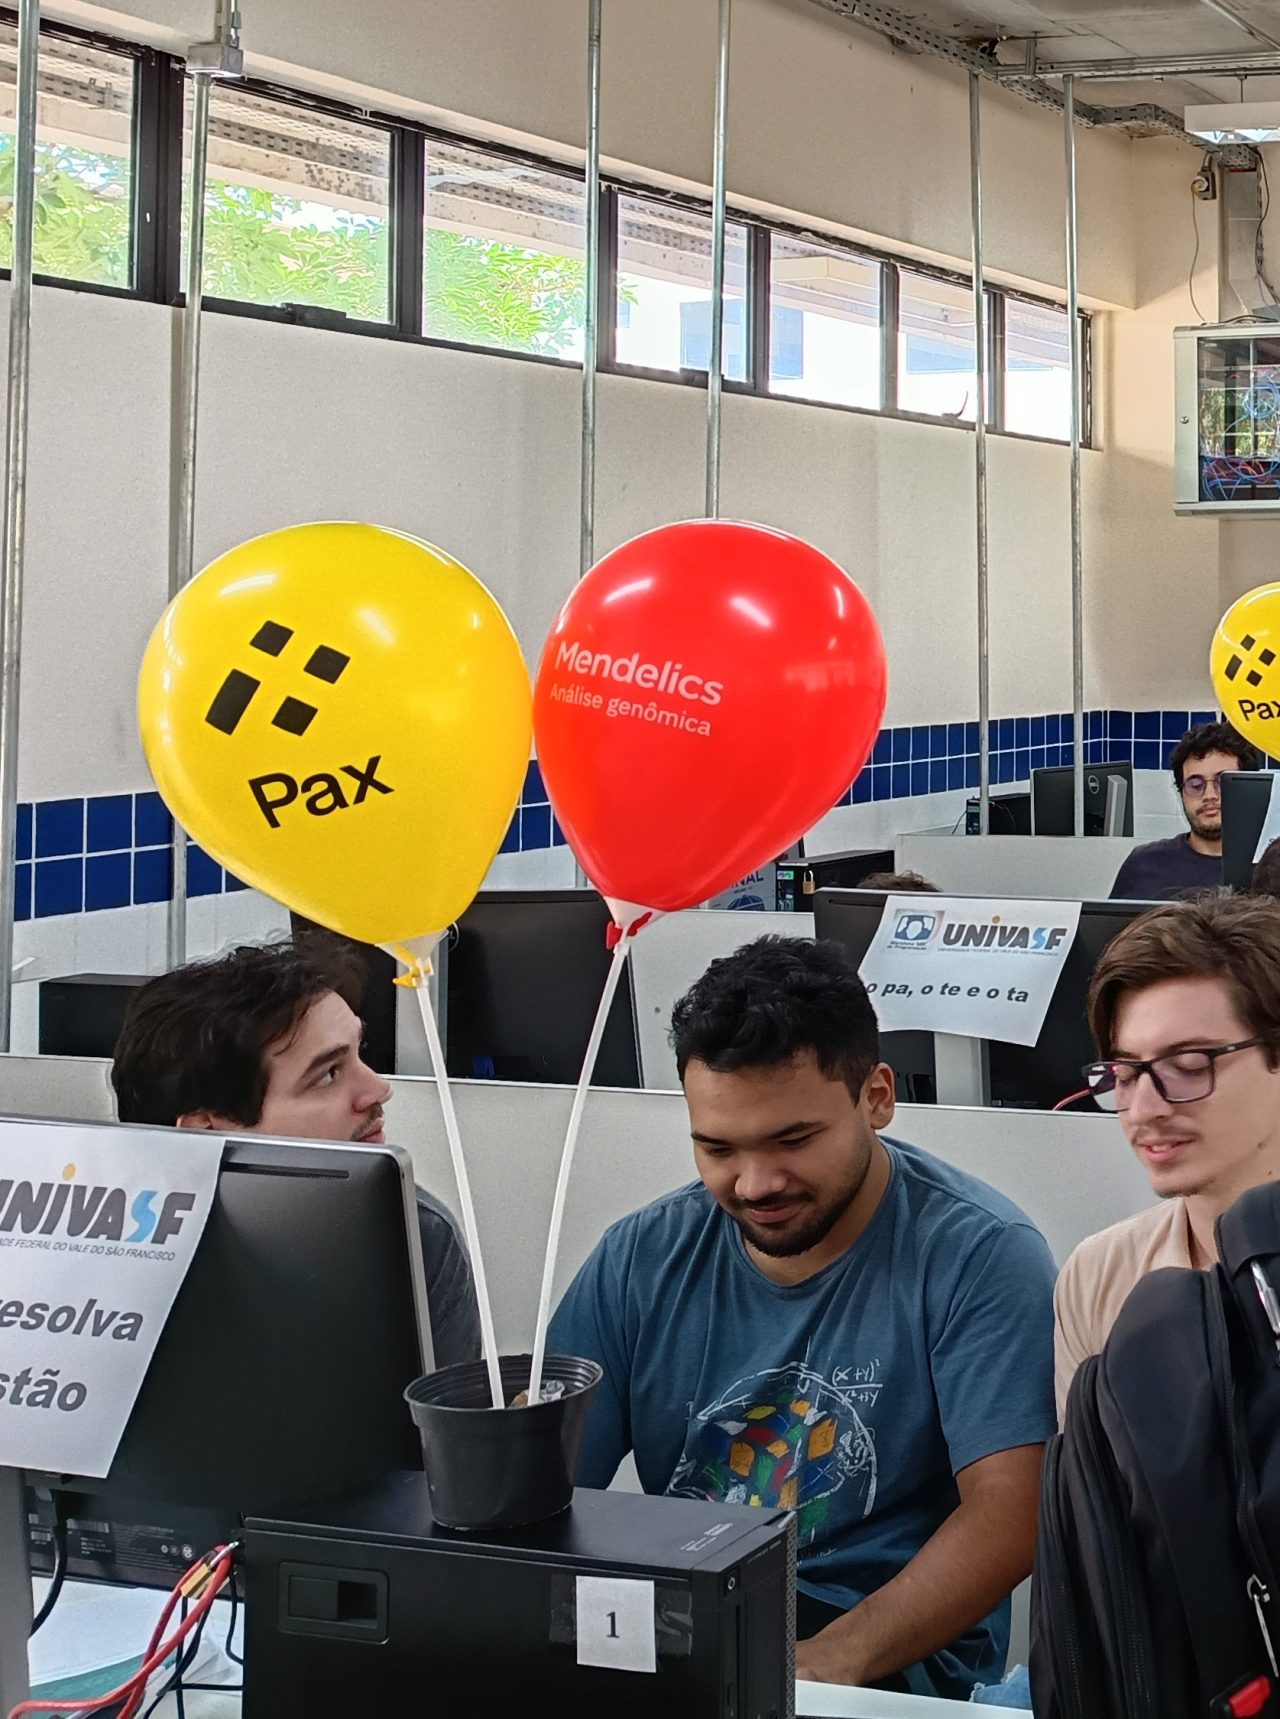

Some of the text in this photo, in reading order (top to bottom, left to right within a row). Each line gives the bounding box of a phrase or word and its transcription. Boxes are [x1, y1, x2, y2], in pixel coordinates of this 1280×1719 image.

[554, 640, 724, 706] Mendelics
[549, 683, 712, 737] Análise genômica
[247, 755, 395, 829] Pax
[942, 915, 1068, 951] UNIVASF
[881, 983, 913, 998] pa,
[920, 984, 934, 995] o
[940, 982, 961, 996] te
[967, 986, 980, 997] e
[986, 987, 1000, 999] o
[1006, 986, 1029, 1003] ta
[15, 1239, 52, 1250] FEDERAL
[53, 1242, 67, 1251] DO
[68, 1243, 90, 1253] VALE
[90, 1245, 105, 1255] DO
[105, 1246, 125, 1257] SÃO
[125, 1249, 176, 1261] FRANCISCO
[0, 1298, 144, 1342] esolva
[605, 1611, 621, 1640] 1
